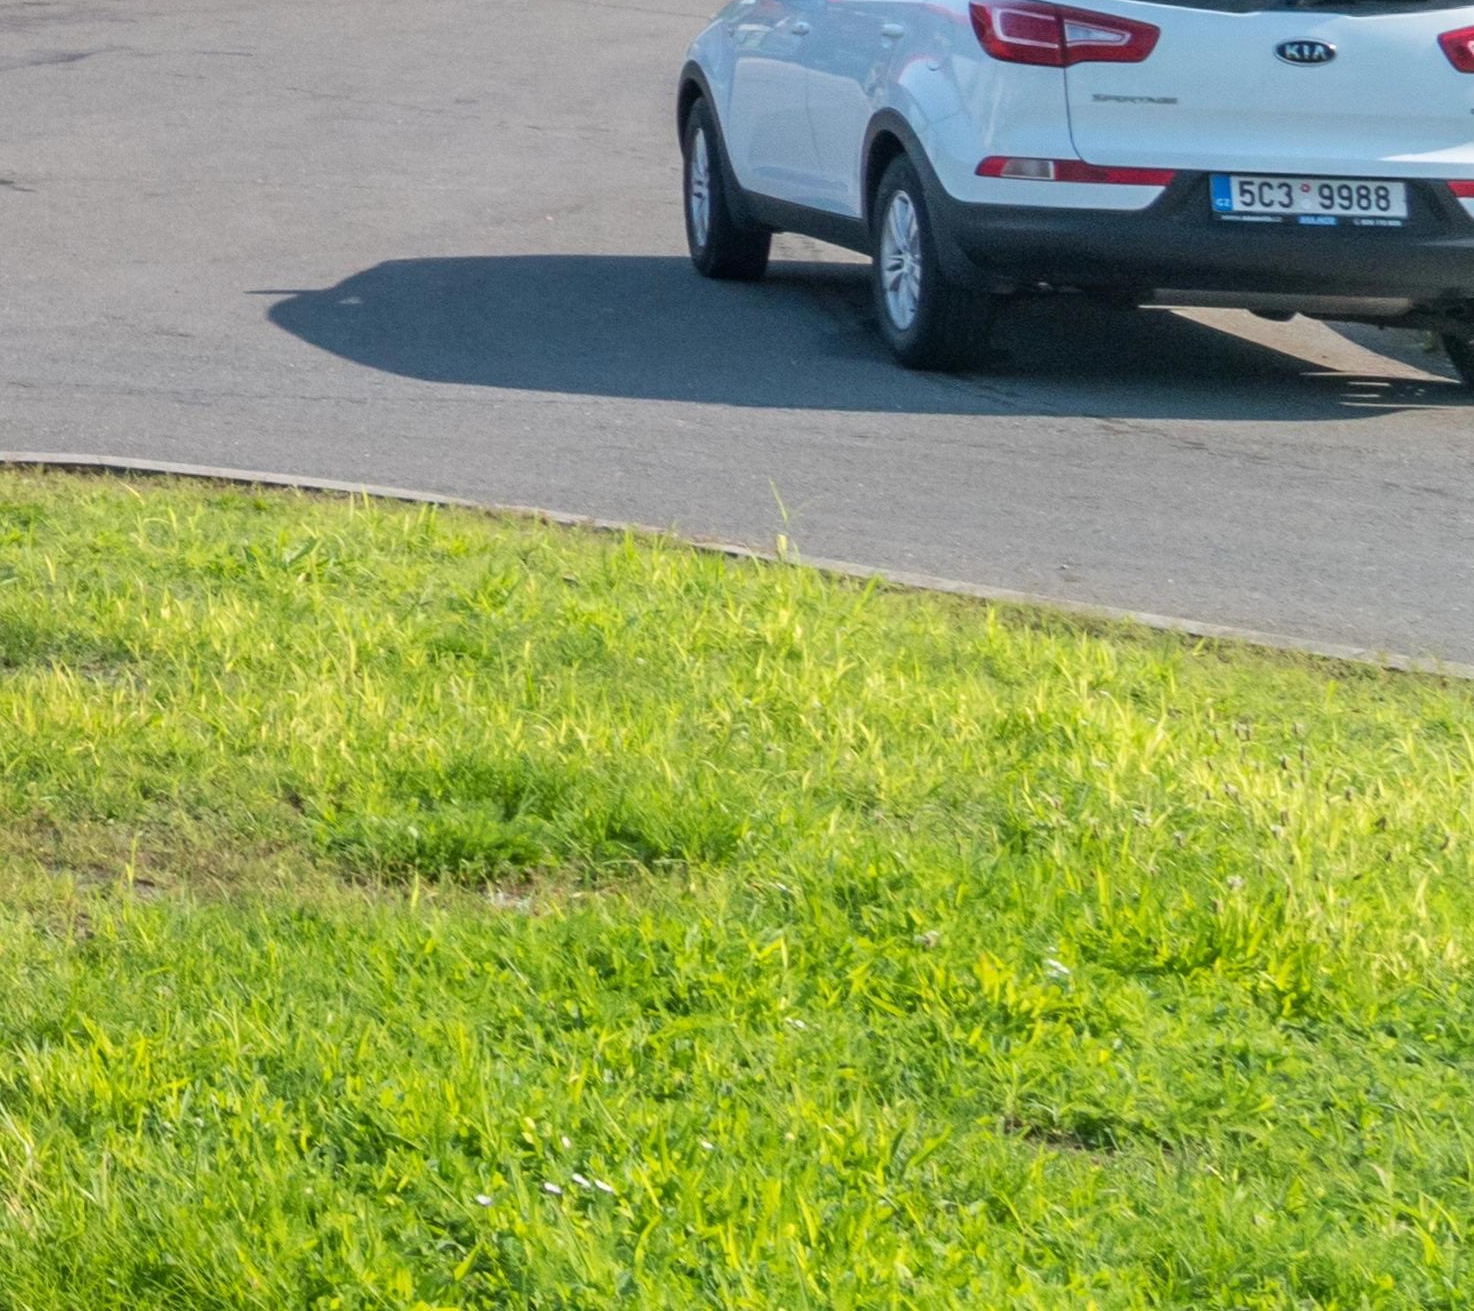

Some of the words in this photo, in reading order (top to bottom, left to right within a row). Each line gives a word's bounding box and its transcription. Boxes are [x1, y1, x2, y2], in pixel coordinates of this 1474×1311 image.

[1283, 43, 1327, 60] KIA
[1216, 199, 1231, 208] CZ
[1238, 180, 1294, 208] 5C3
[1318, 183, 1391, 212] 9988
